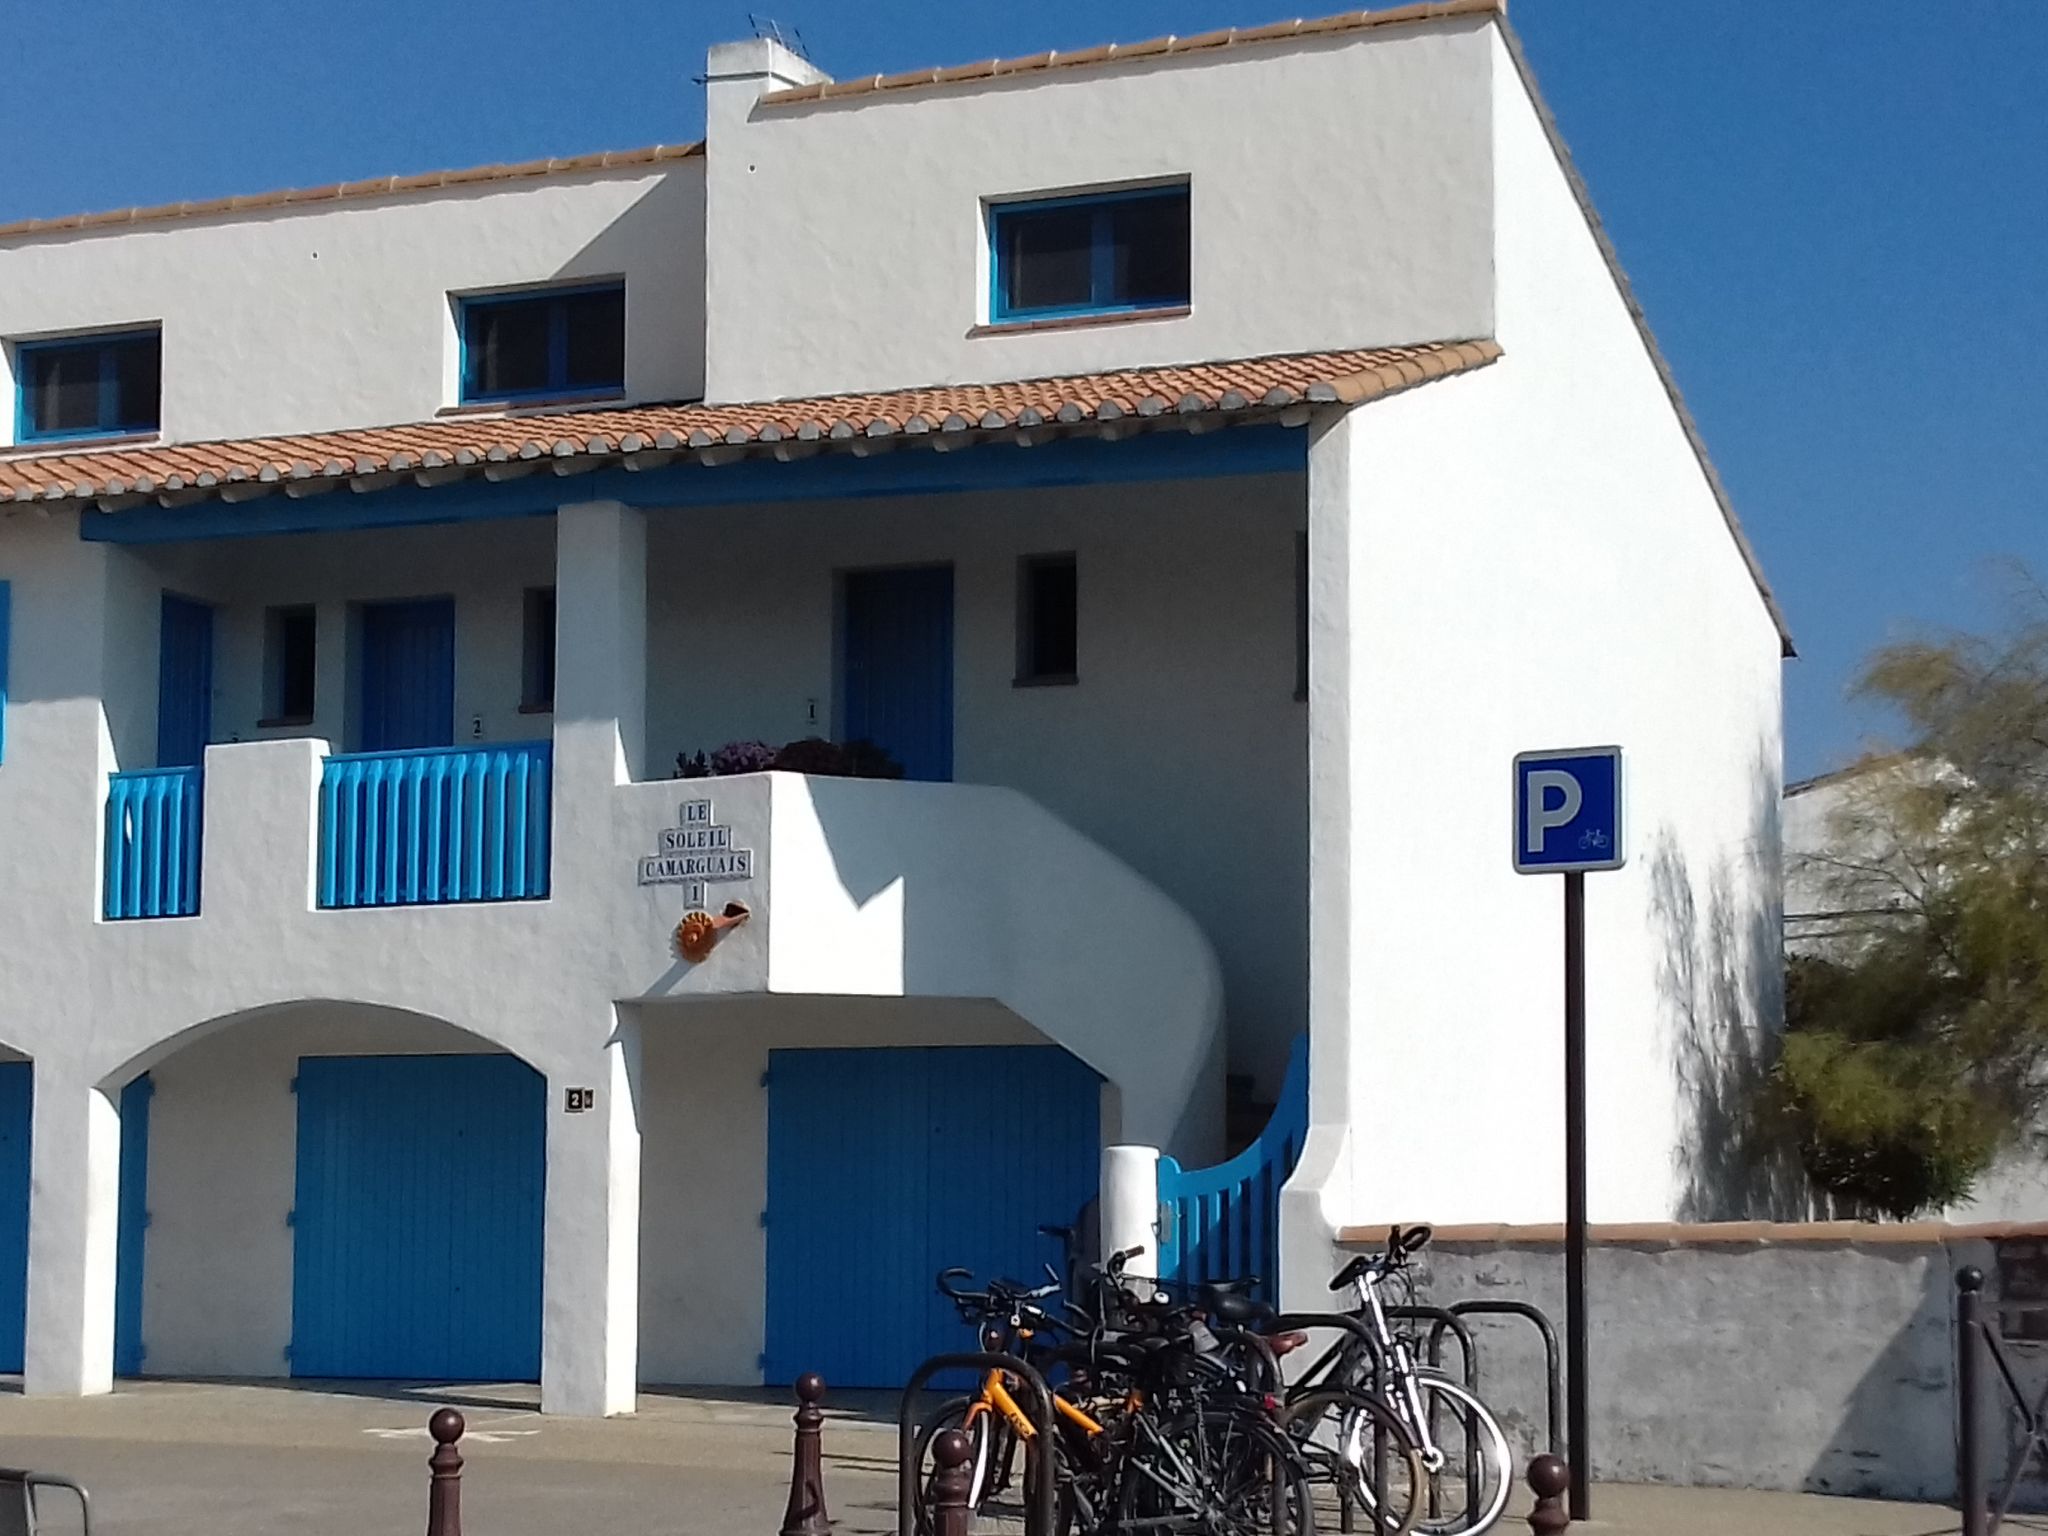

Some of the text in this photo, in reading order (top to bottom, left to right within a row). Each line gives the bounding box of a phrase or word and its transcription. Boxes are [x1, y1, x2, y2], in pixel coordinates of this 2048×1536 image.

[687, 804, 707, 821] LE
[1527, 769, 1582, 852] P
[665, 829, 727, 849] SOLEIL
[645, 855, 747, 877] CAMARGUAIS
[571, 1092, 580, 1106] 2
